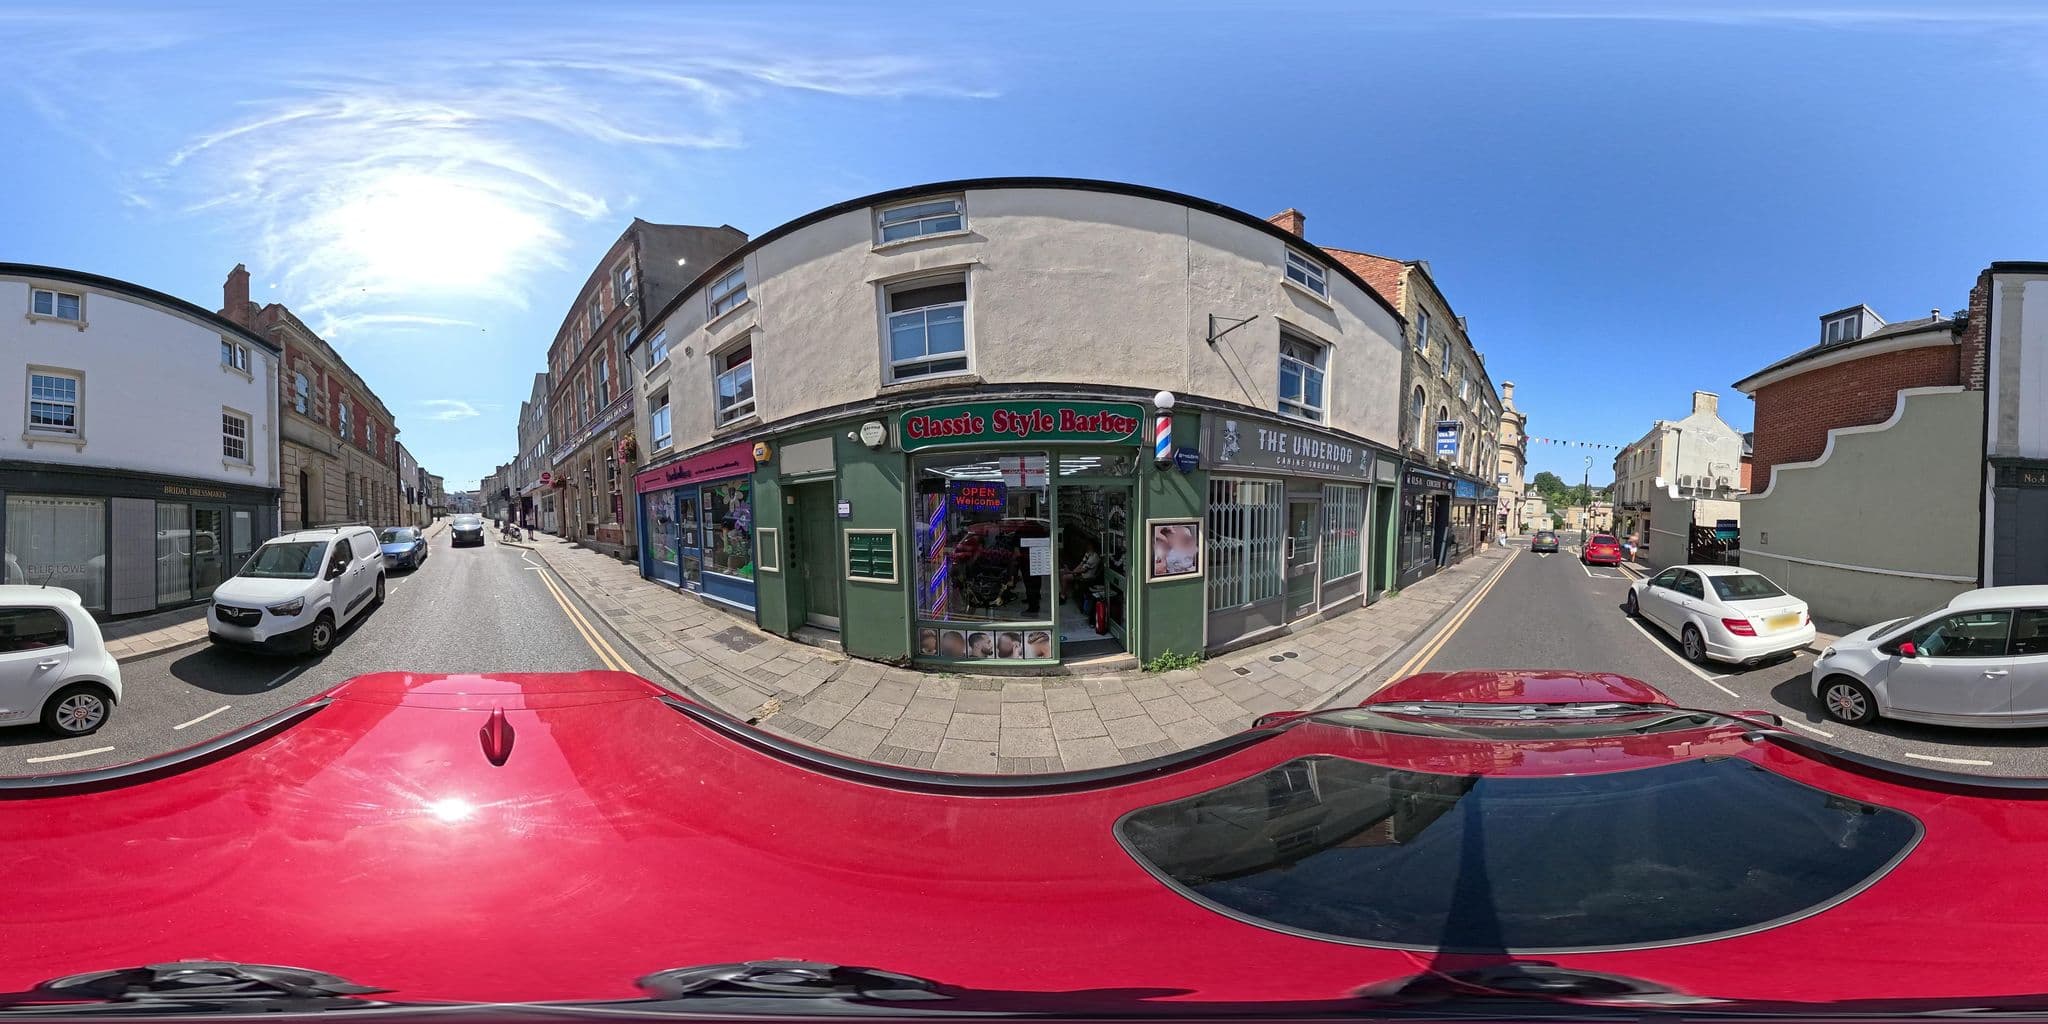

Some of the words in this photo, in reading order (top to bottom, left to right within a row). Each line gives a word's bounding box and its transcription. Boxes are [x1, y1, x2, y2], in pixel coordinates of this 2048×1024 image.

[907, 412, 984, 438] Classic
[992, 409, 1054, 437] Style
[1058, 409, 1138, 433] Barber
[1259, 429, 1287, 452] THE
[1293, 436, 1352, 464] UNDERDOG
[1276, 456, 1305, 467] CANINE
[164, 485, 187, 496] BRIDAL
[962, 487, 996, 497] OPEN
[955, 496, 1001, 506] Welcome
[56, 564, 86, 575] LOWE
